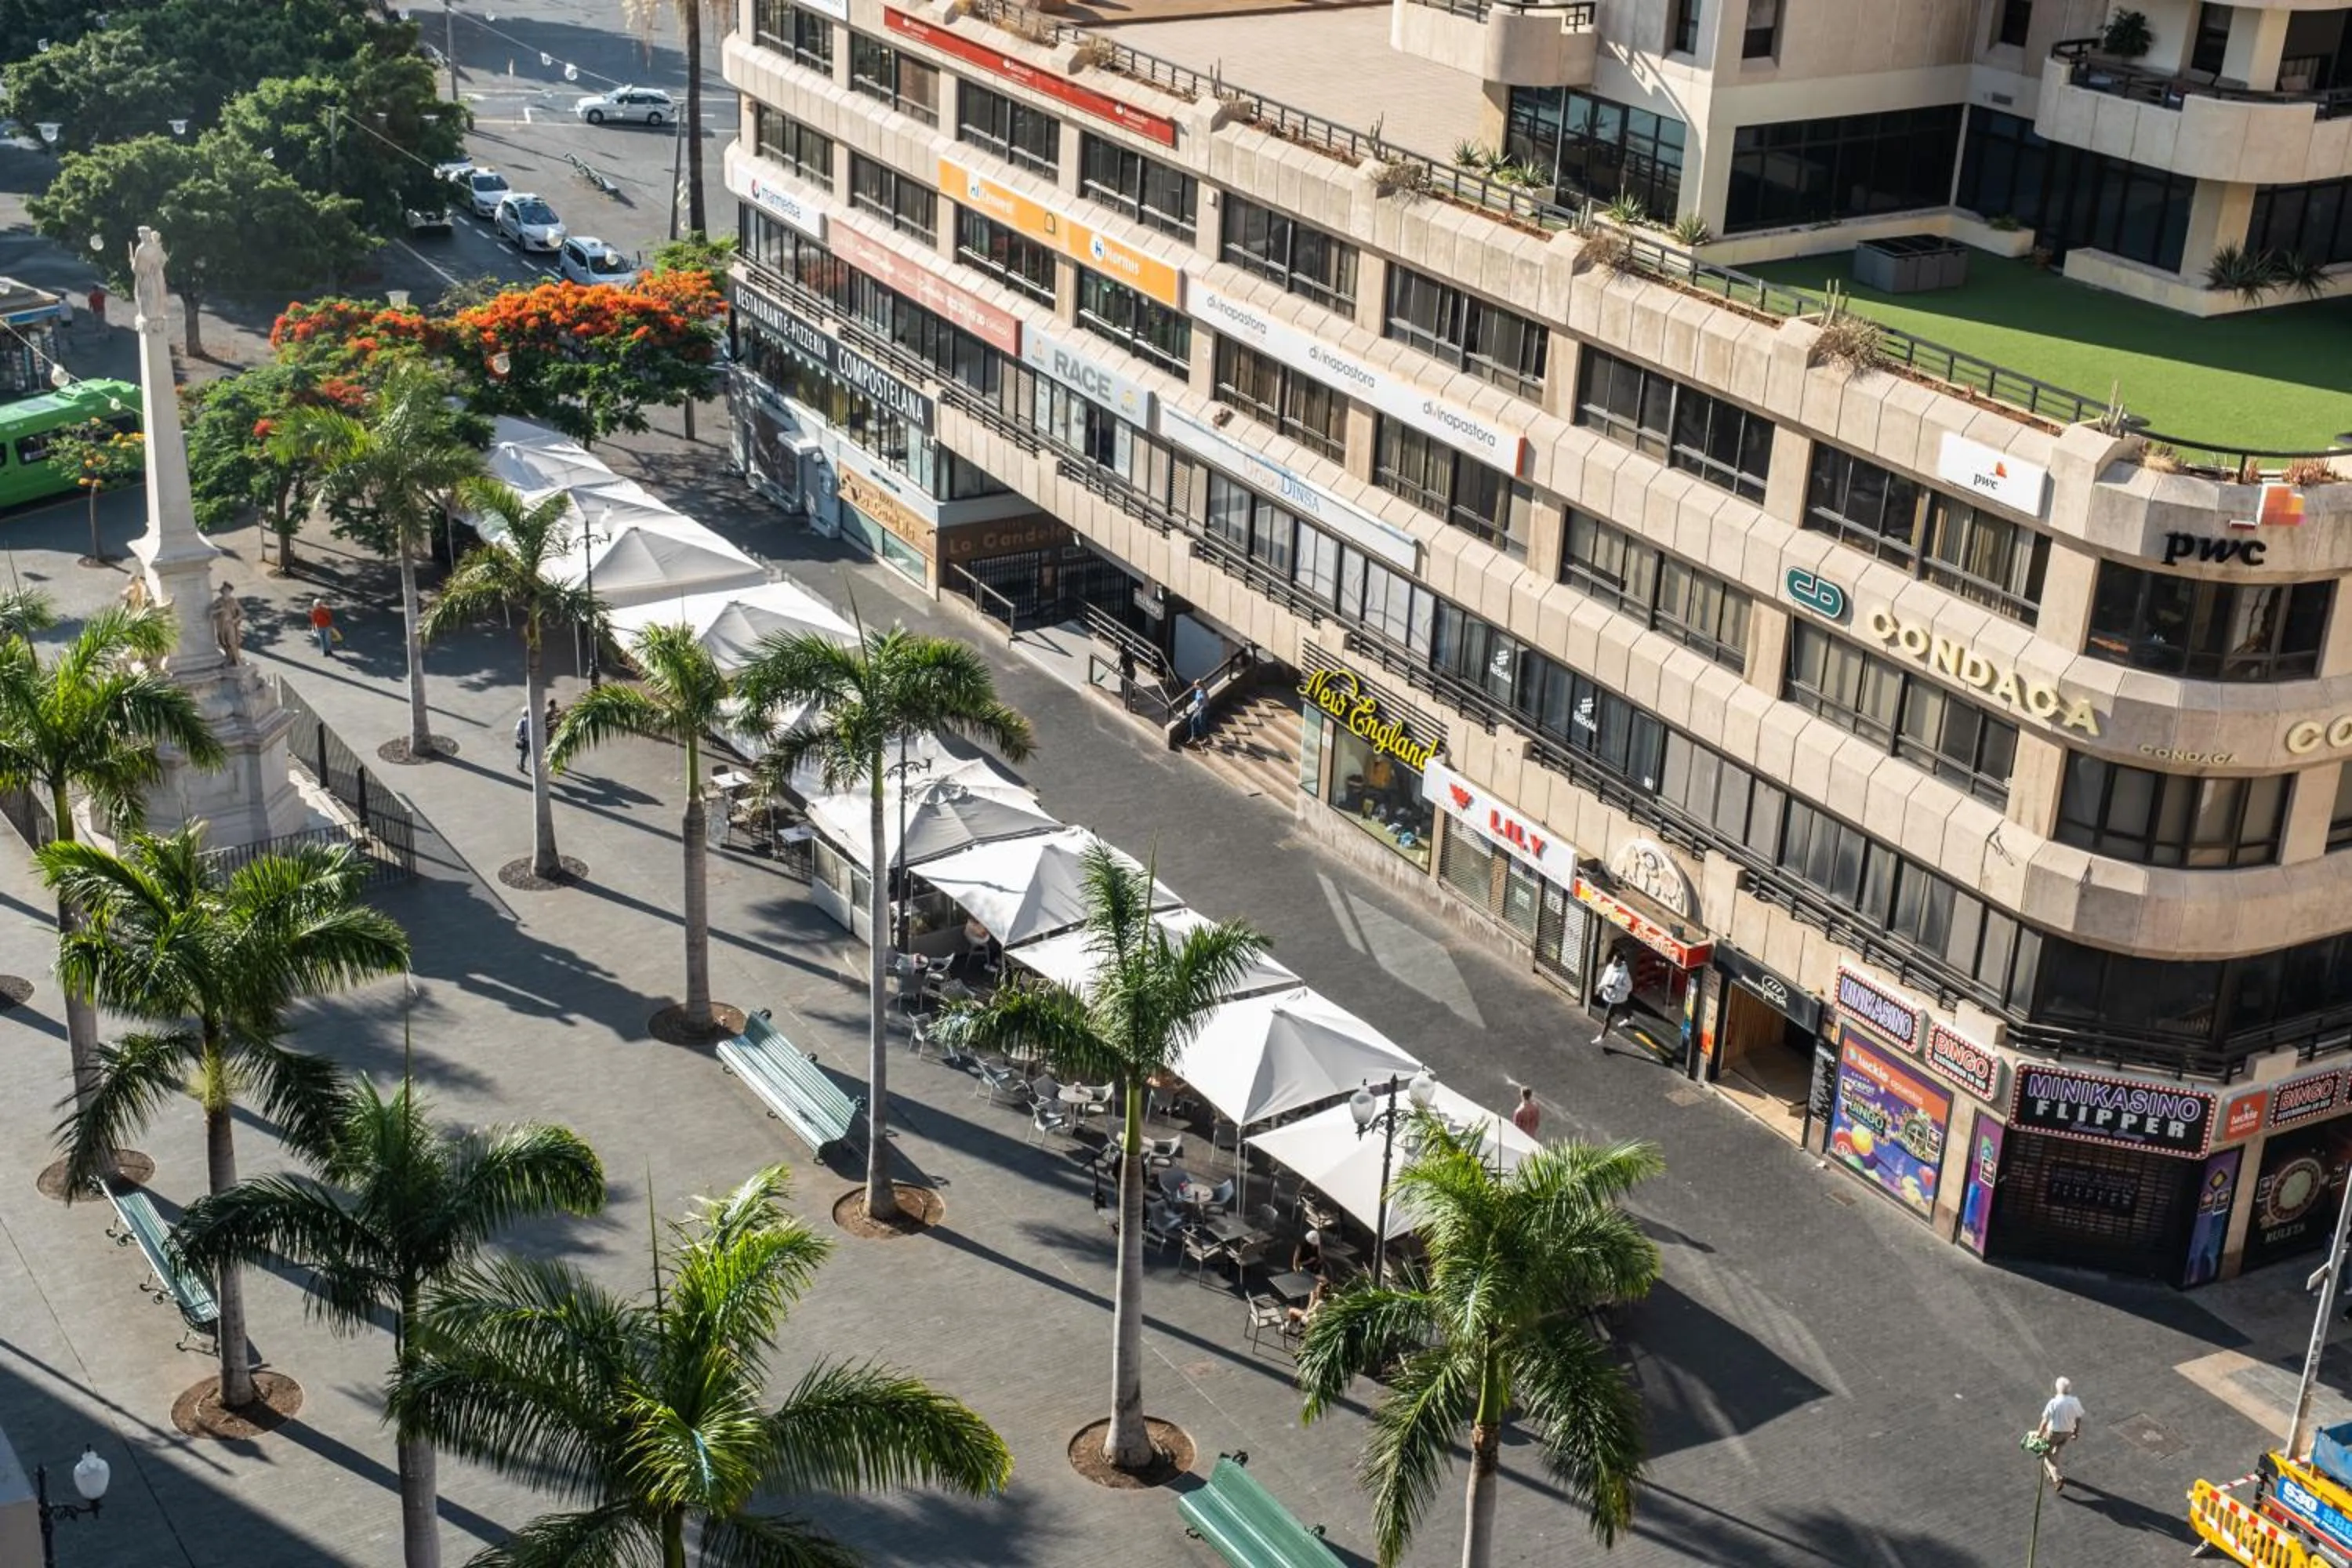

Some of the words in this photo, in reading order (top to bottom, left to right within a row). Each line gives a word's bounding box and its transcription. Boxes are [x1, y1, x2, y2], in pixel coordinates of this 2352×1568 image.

[837, 348, 924, 426] COMPOSTELANA
[1054, 349, 1112, 403] RACE
[1973, 472, 1998, 490] pwc
[2161, 532, 2267, 566] pwc
[1296, 668, 1359, 717] New
[1349, 694, 1439, 765] England
[1490, 808, 1546, 859] LILY
[1936, 1033, 1989, 1080] BINGO
[2027, 1073, 2201, 1122] MINIKASINO
[2281, 1078, 2334, 1109] BINGO
[2035, 1100, 2186, 1139] FLIPPER
